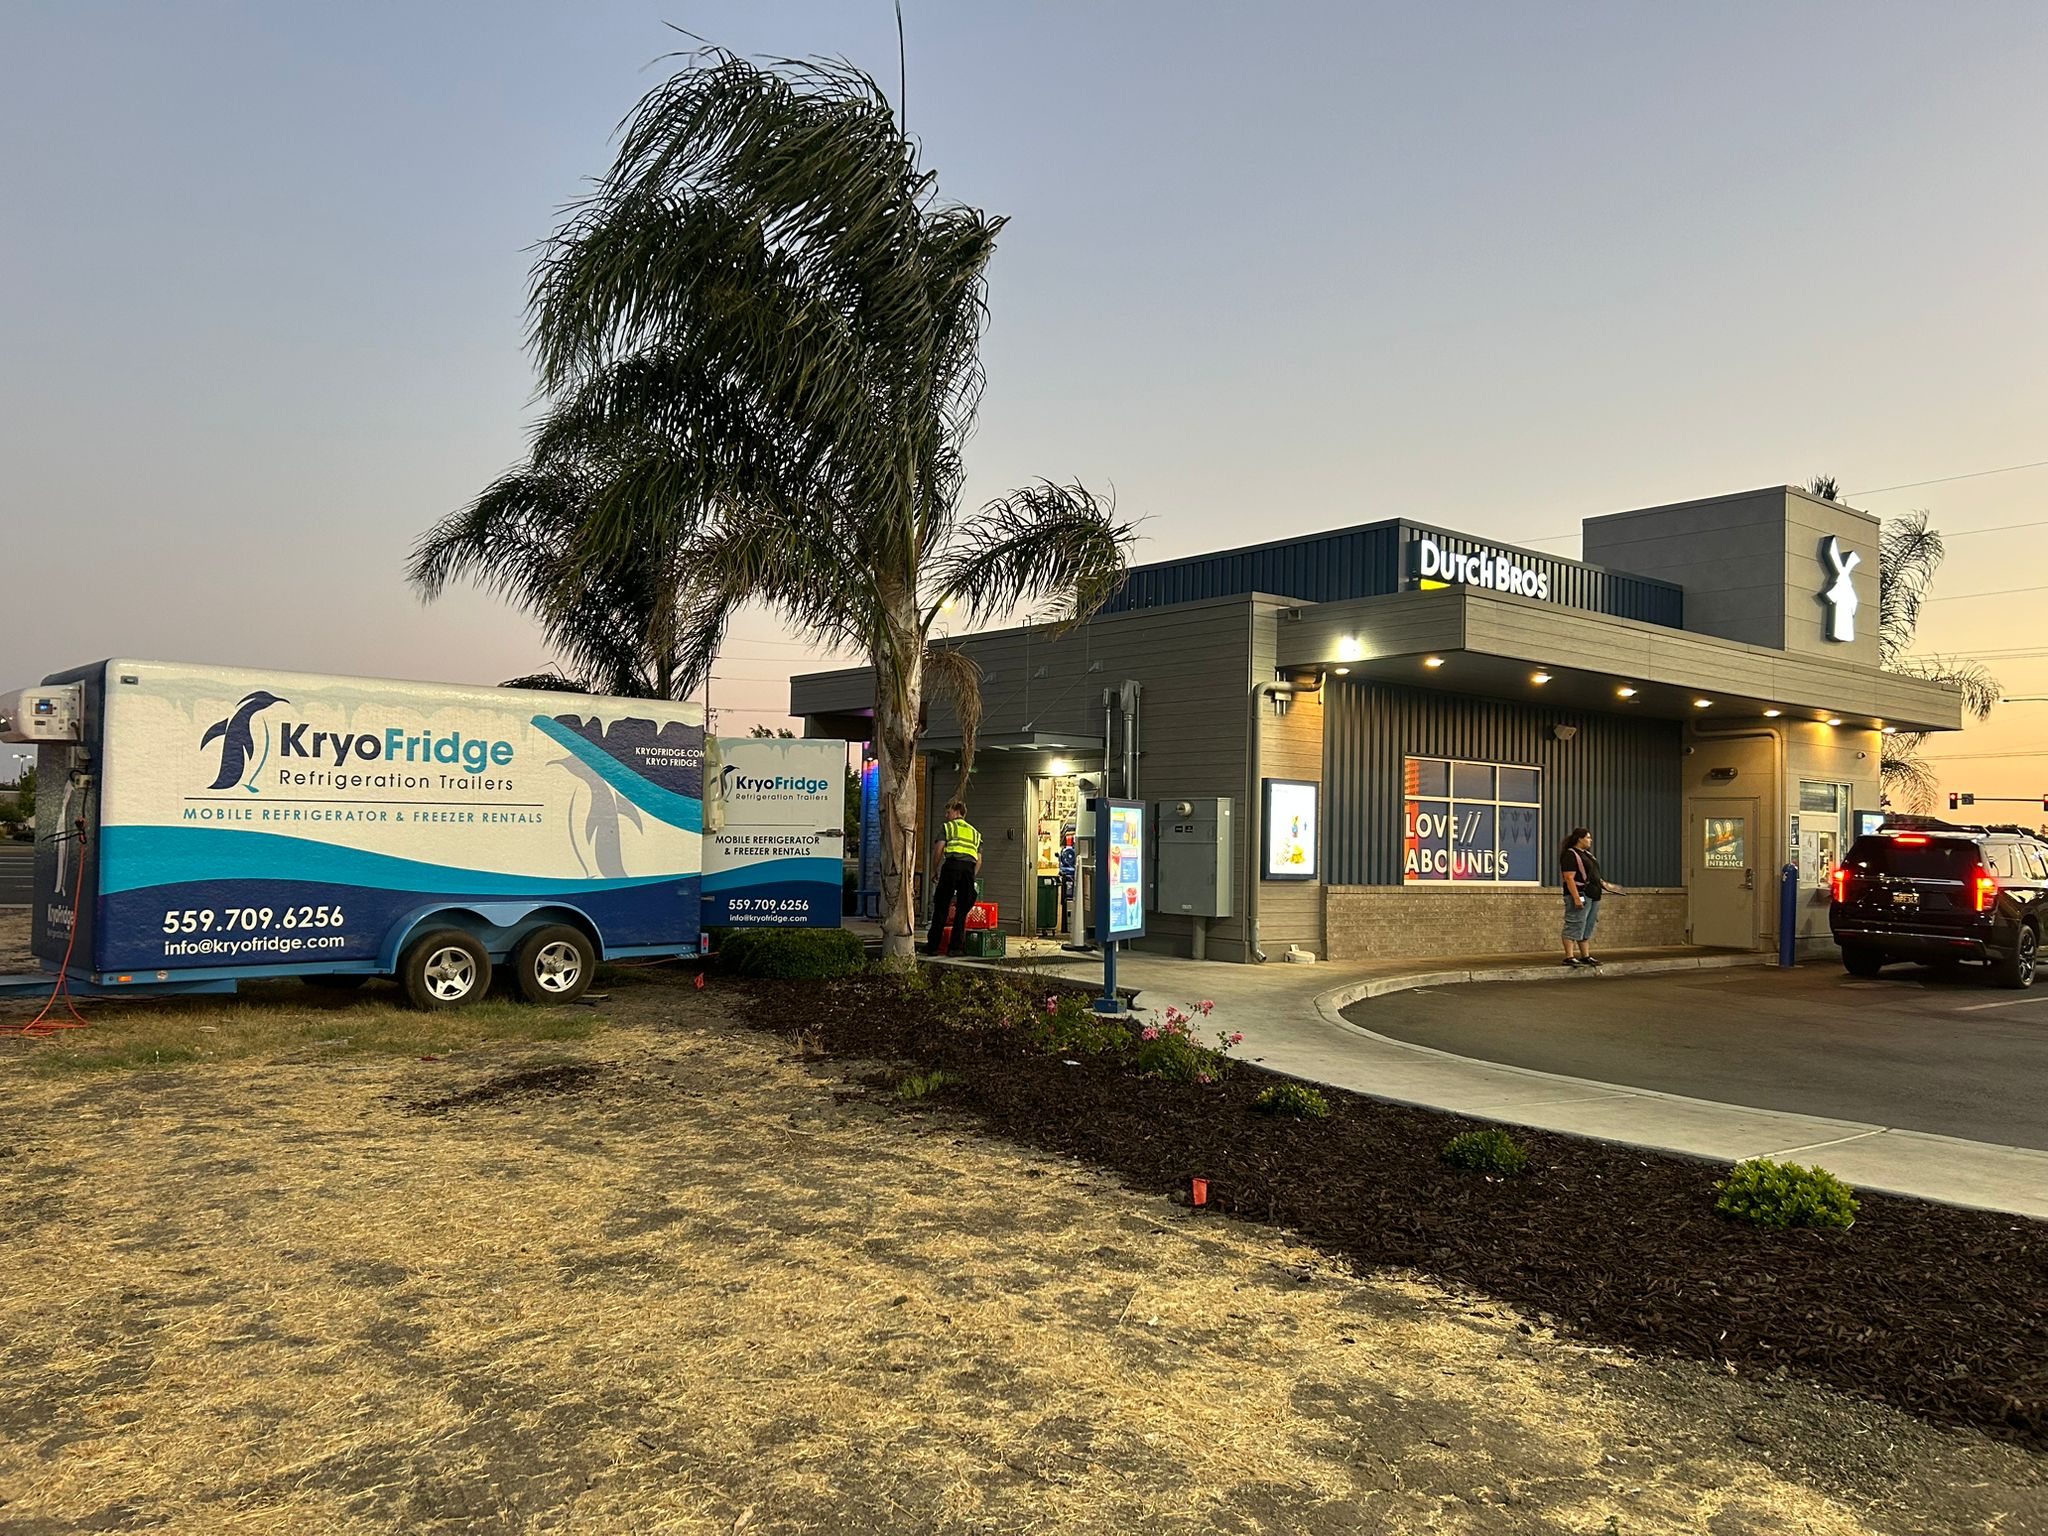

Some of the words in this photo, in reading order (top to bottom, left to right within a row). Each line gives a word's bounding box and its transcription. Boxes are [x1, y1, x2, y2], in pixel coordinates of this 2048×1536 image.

[1421, 539, 1493, 589] DUTCH
[1496, 556, 1548, 600] BROS
[281, 722, 514, 774] KryoFridge
[646, 757, 668, 766] KRYO
[670, 758, 698, 767] FRIDGE
[280, 770, 430, 790] Refrigeration
[440, 775, 513, 791] Trailers
[736, 776, 829, 794] KryoFridge
[736, 793, 794, 801] Refrigeration
[183, 808, 252, 820] MOBILE
[262, 809, 387, 821] REFRIGERATOR
[396, 811, 405, 822] &
[413, 811, 474, 823] FREEZER
[482, 812, 543, 823] RENTALS
[715, 835, 751, 844] MOBILE
[753, 836, 820, 844] REFRIGERATOR
[734, 847, 770, 855] FREEZER
[772, 847, 811, 856] RENTALS
[1405, 848, 1509, 875] ABOUNDS
[1706, 860, 1744, 868] NTRANCE
[728, 899, 809, 911] 559.709.6256
[163, 905, 344, 934] 559.709.6256
[729, 914, 808, 923] info@kryofridge.com
[165, 936, 345, 956] info@kryofridge.com
